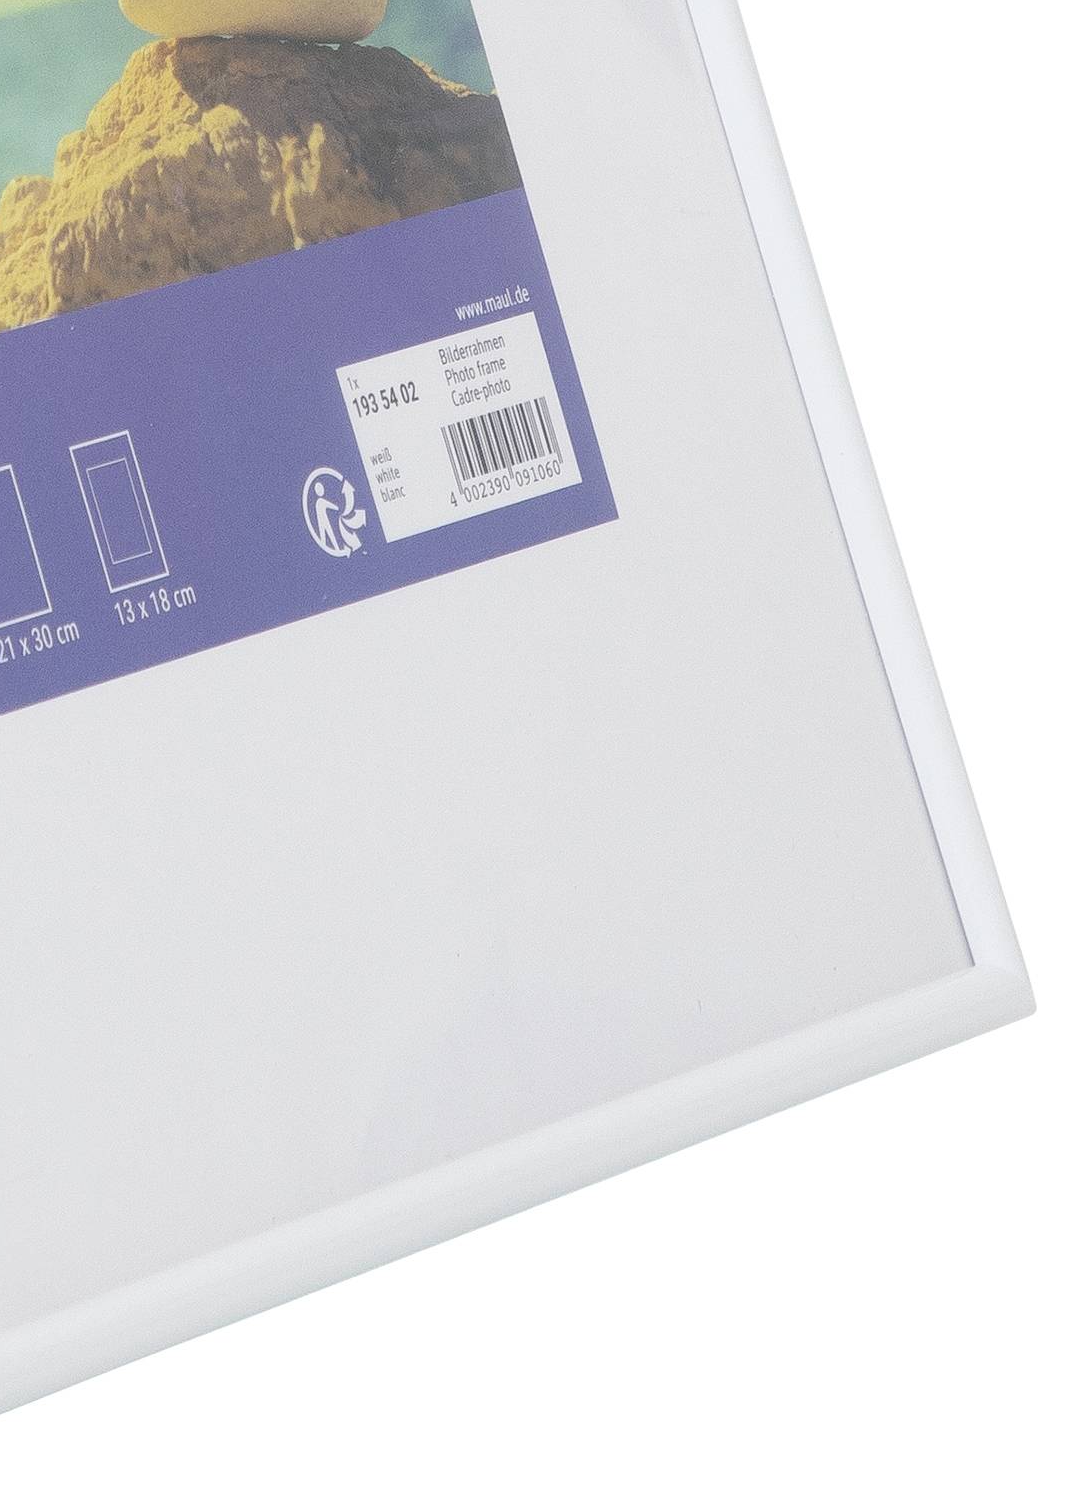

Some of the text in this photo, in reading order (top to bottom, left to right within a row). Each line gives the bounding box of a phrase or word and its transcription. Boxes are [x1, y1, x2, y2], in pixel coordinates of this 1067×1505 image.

[455, 285, 531, 321] www.maul.de
[439, 335, 506, 365] Bilderrahmen
[347, 377, 360, 391] 1x
[445, 356, 507, 386] Photo frame
[352, 381, 420, 419] 193 54 02
[451, 378, 512, 407] Cadre-photo
[370, 447, 393, 466] weiß
[375, 466, 401, 485] white
[450, 460, 562, 507] 4 002390 091060
[381, 485, 406, 503] blanc
[114, 585, 197, 625] 13 x 18 cm
[19, 638, 31, 656] x
[31, 624, 54, 651] 30
[57, 621, 80, 644] cm
